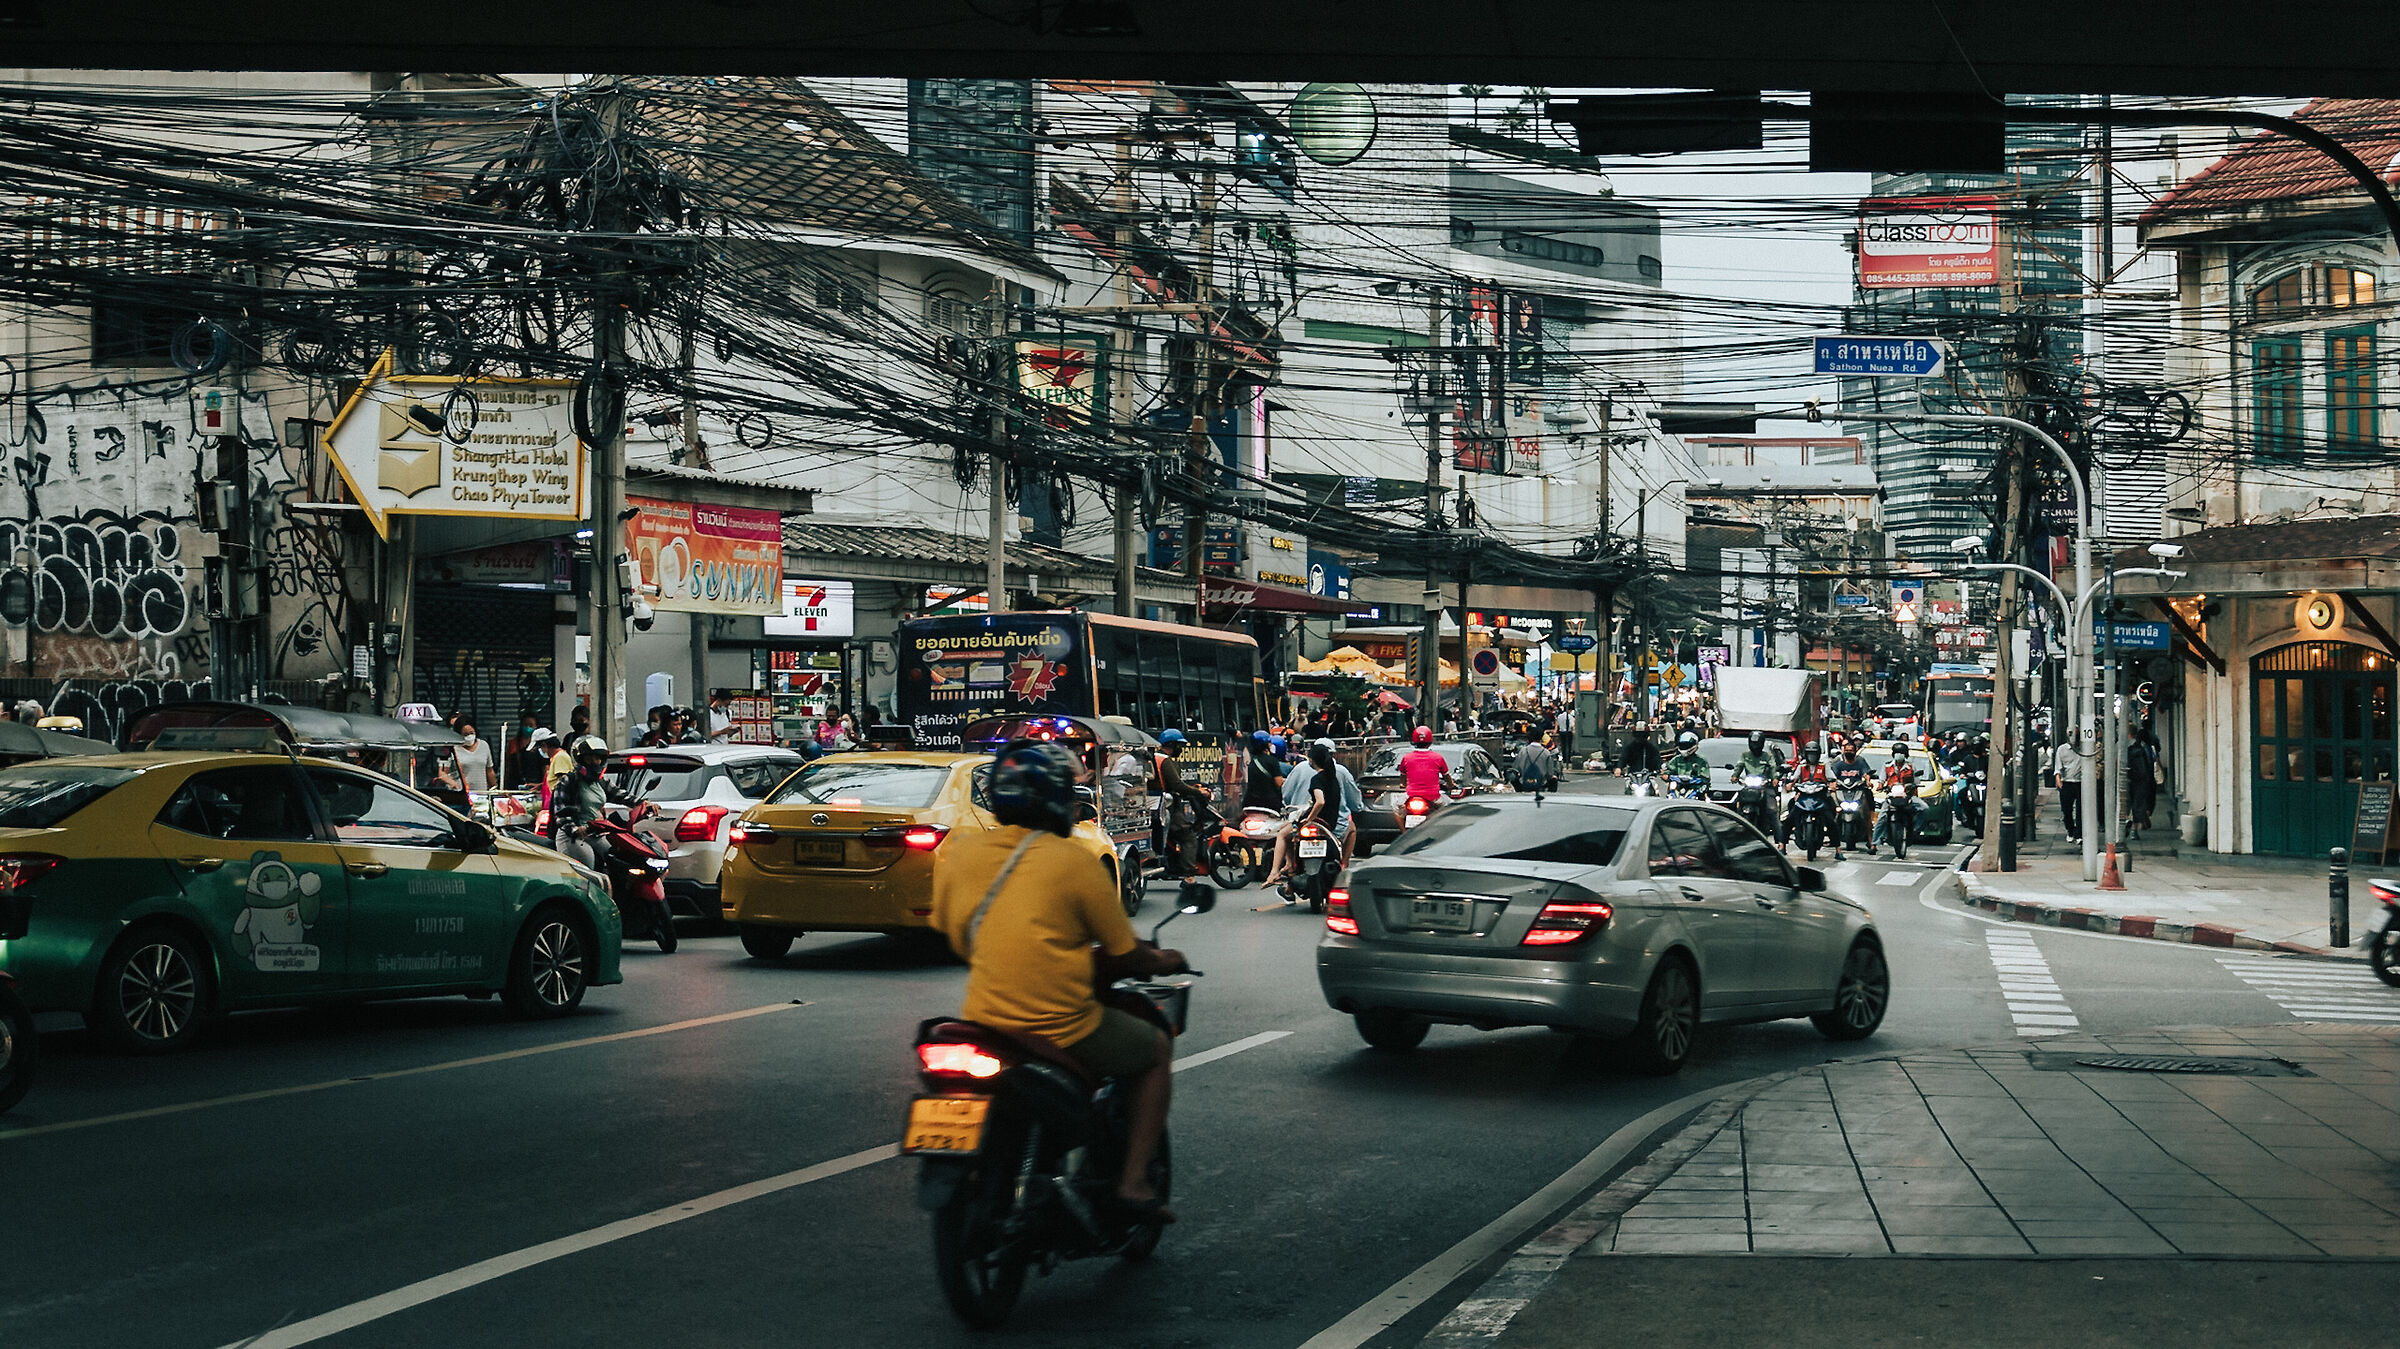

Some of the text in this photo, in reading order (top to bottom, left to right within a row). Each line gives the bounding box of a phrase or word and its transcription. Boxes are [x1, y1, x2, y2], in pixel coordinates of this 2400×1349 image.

[1867, 218, 1989, 242] Classroom
[1821, 340, 1927, 361] ถ. สาทรเหนือ
[1829, 362, 1919, 372] Sathon Nuea Rd.
[452, 447, 569, 468] Shangri-La Hotel
[1514, 438, 1540, 460] Tops
[452, 467, 569, 490] Krungthep Wing
[451, 486, 571, 510] Chao Phya Tower
[690, 558, 779, 605] SUNWAY
[984, 617, 992, 626] 1
[1510, 617, 1553, 628] McDonald's
[915, 626, 1062, 650] ยอดขายอันดับหนึ่ง
[1379, 646, 1404, 656] FIVE
[1021, 660, 1044, 695] 7
[401, 706, 428, 717] TAXI
[914, 714, 959, 729] รู้สึกได้ว่า
[2083, 729, 2093, 739] 10
